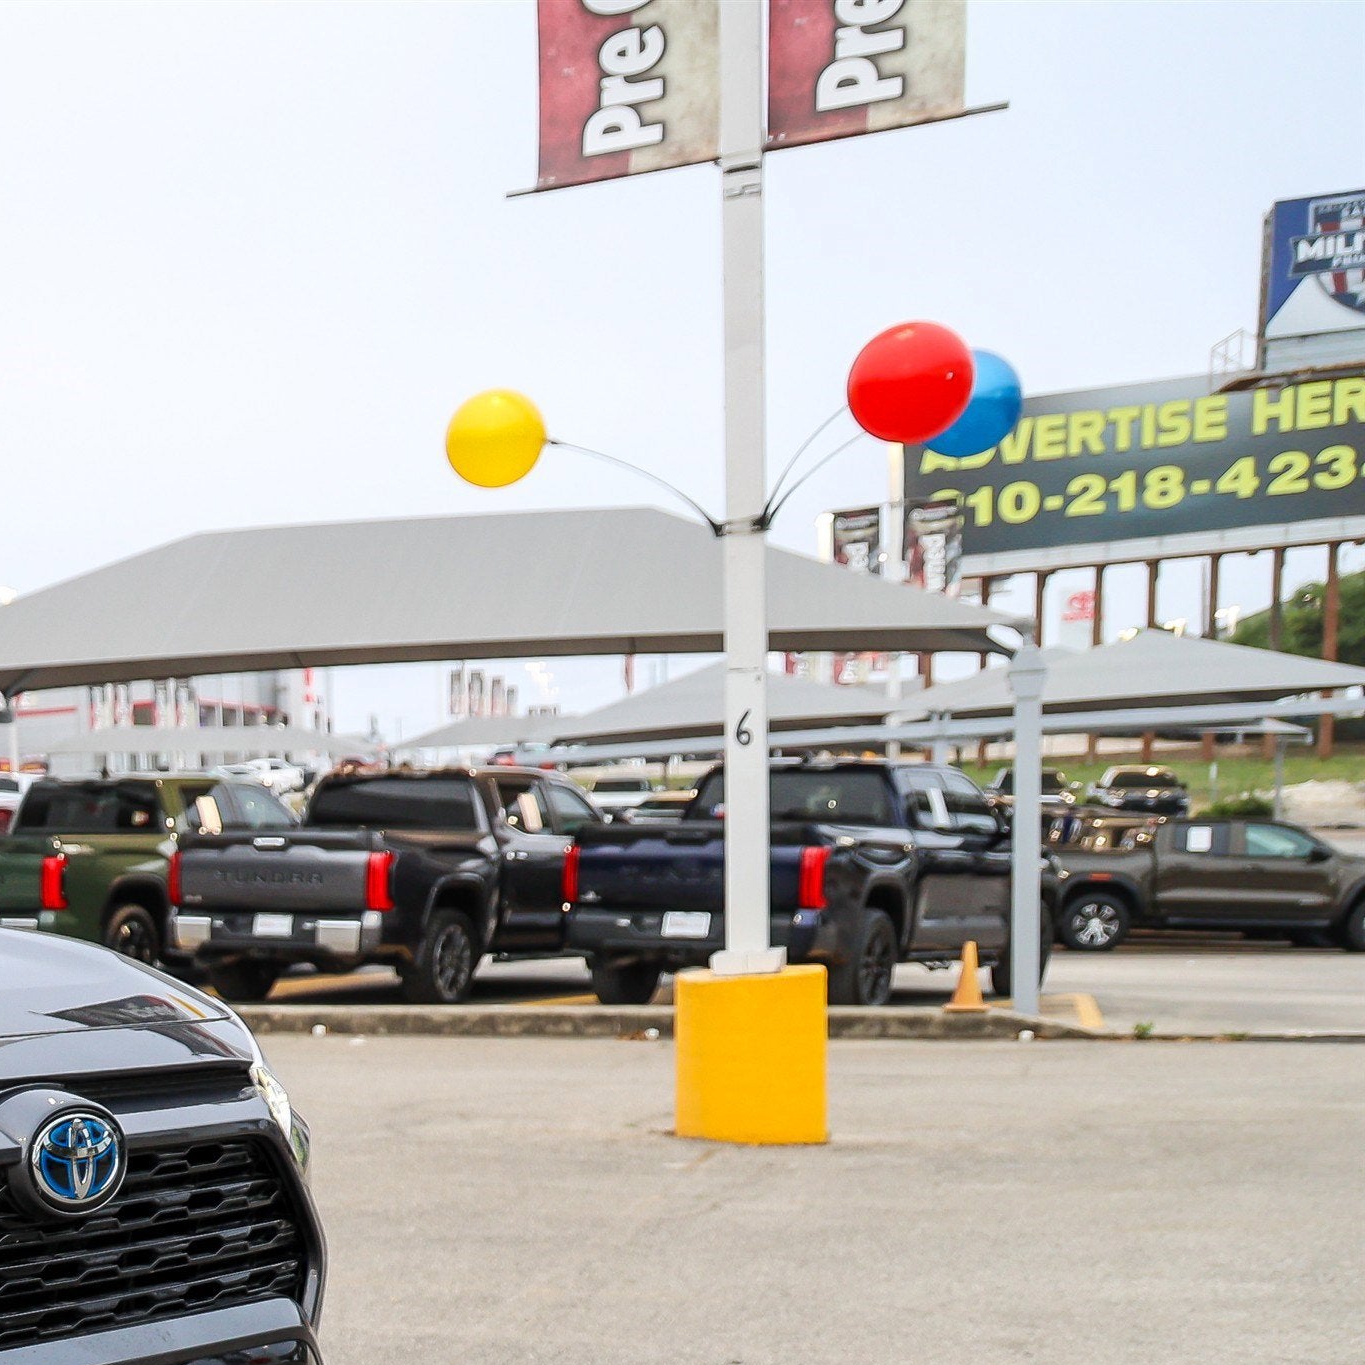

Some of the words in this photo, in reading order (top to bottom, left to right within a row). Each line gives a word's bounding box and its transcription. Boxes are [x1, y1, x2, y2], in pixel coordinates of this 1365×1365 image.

[581, 24, 666, 157] Pre
[1252, 377, 1365, 436] HER
[929, 444, 1365, 527] 10-218-423
[736, 709, 752, 746] 6
[216, 870, 324, 885] TUNDRA
